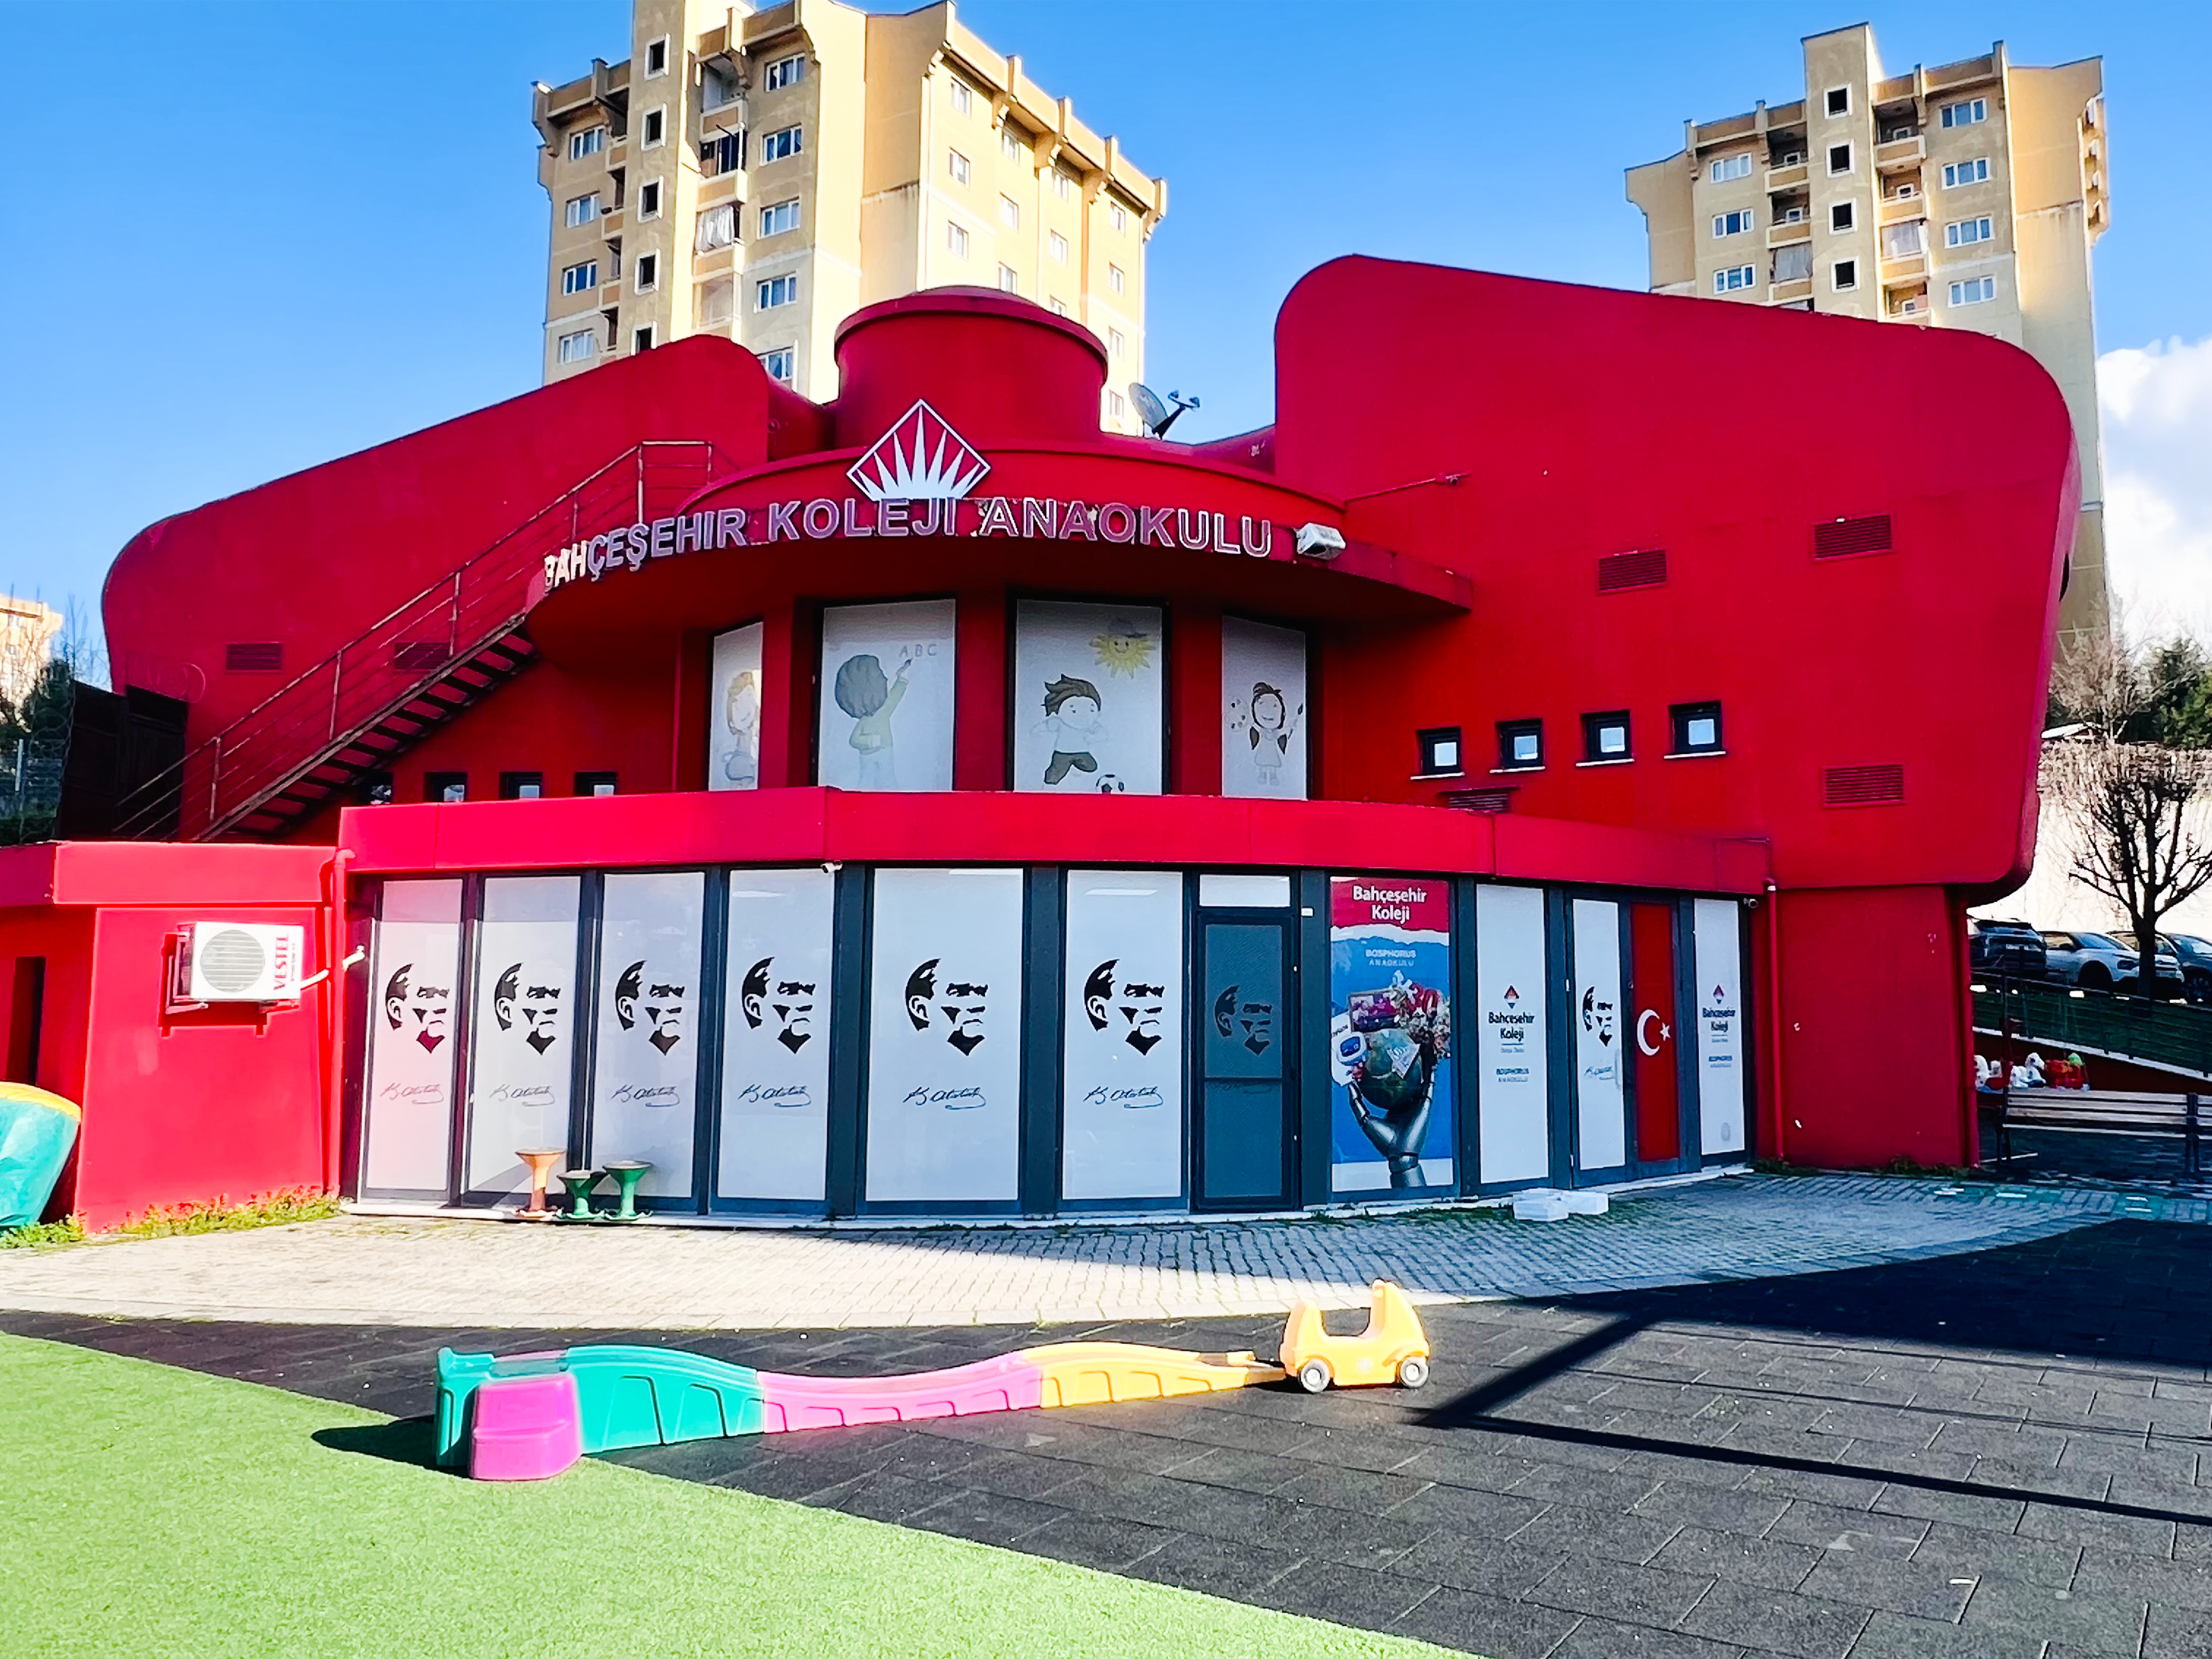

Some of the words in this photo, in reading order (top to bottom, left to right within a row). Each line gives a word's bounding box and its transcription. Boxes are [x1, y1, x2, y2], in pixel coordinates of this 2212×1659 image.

[978, 497, 1271, 557] ANAOKULU
[1353, 885, 1427, 903] Bahçeşehir
[1371, 905, 1410, 924] Koleji
